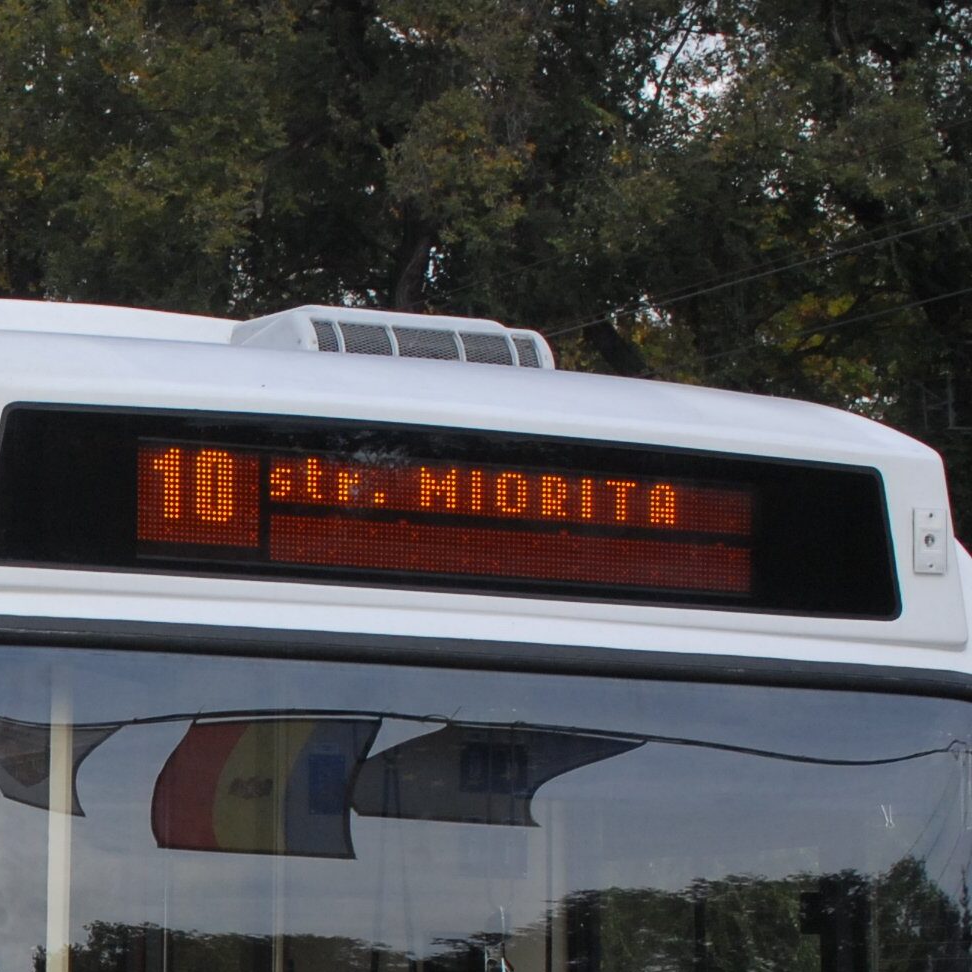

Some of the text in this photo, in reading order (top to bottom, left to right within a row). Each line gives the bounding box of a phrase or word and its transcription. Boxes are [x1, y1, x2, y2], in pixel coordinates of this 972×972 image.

[153, 447, 676, 526] 10 str. MIORITA
